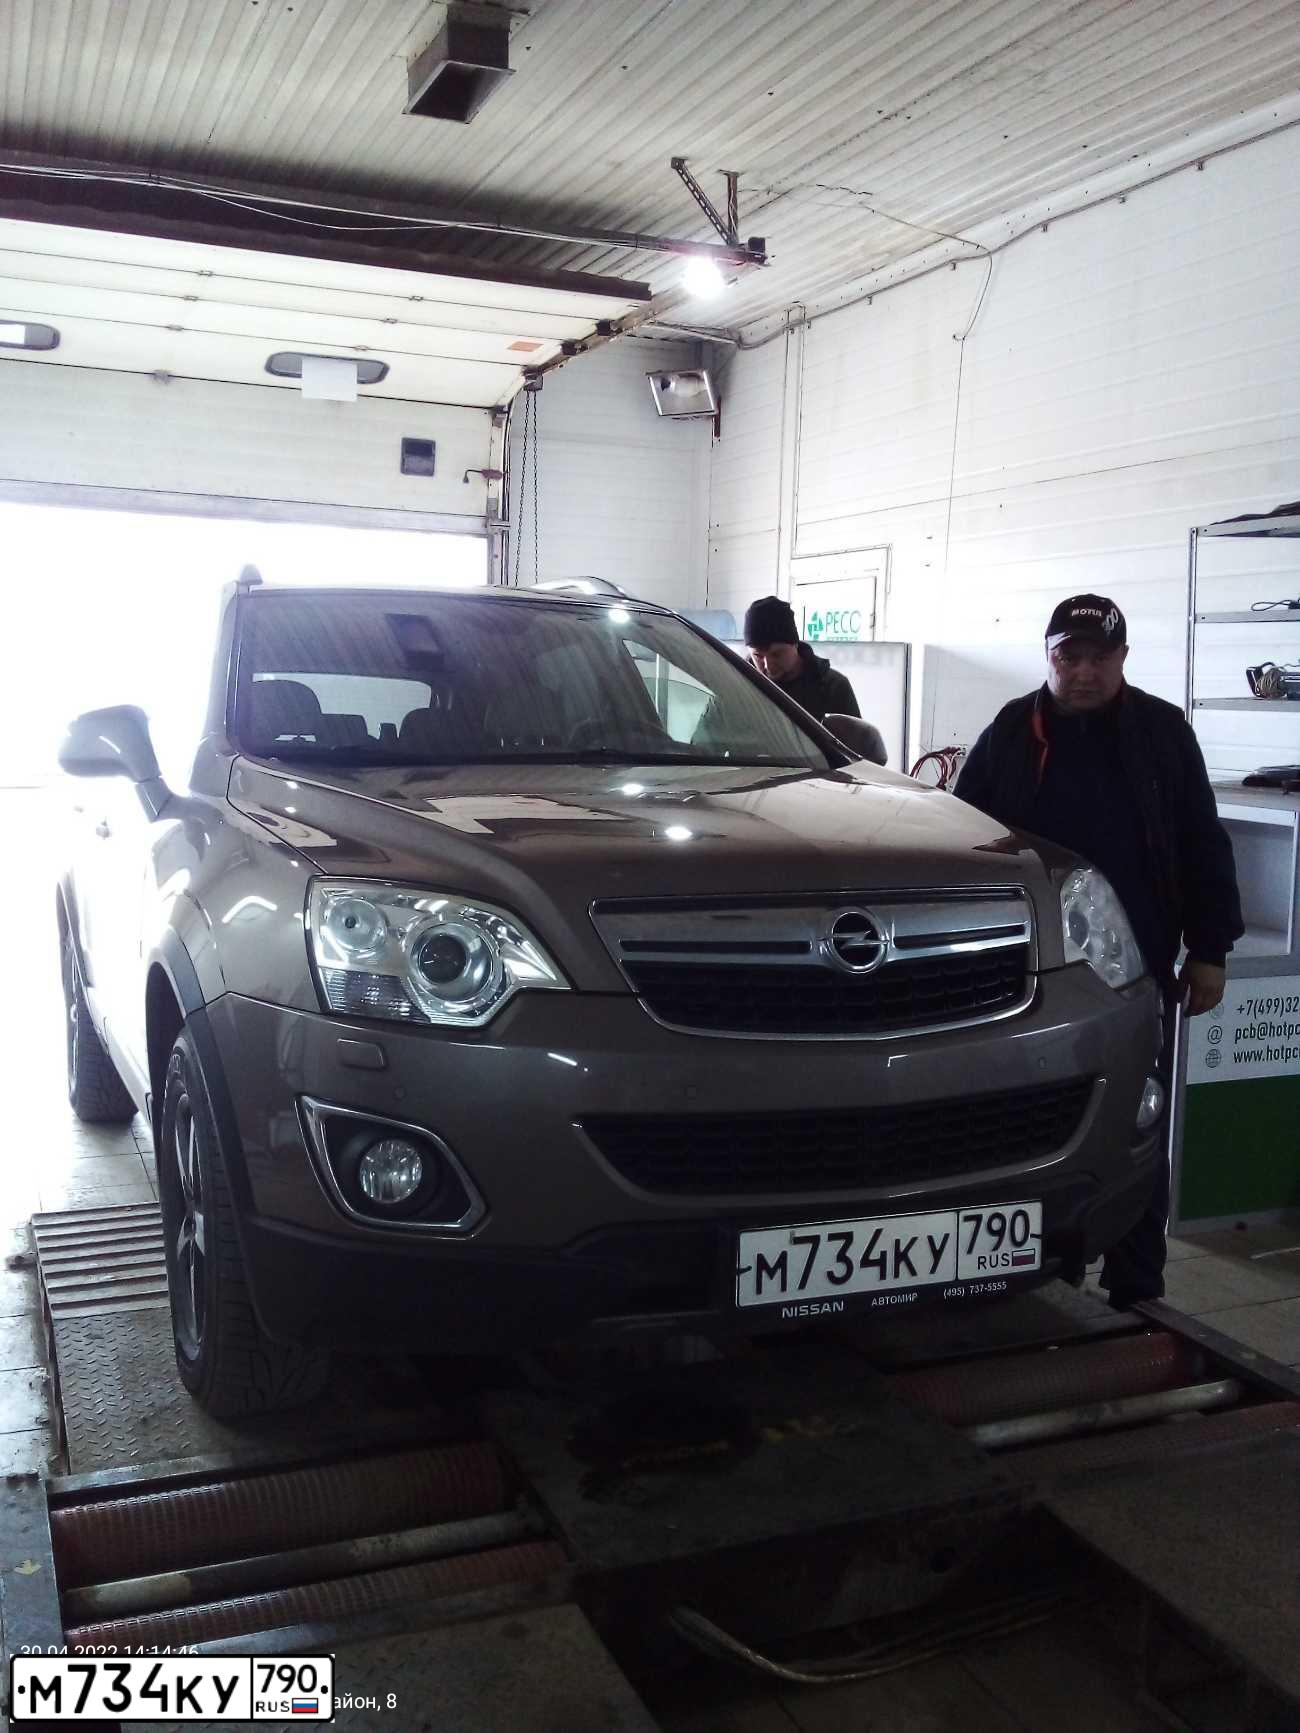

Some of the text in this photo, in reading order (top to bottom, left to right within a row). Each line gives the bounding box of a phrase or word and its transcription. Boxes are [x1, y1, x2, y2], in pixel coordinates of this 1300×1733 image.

[1233, 1044, 1300, 1064] www.hotpc
[963, 1209, 1030, 1255] 790
[977, 1253, 1010, 1270] RUS
[782, 1281, 1007, 1319] NISSAN АВТОМИР (495) 737-5555
